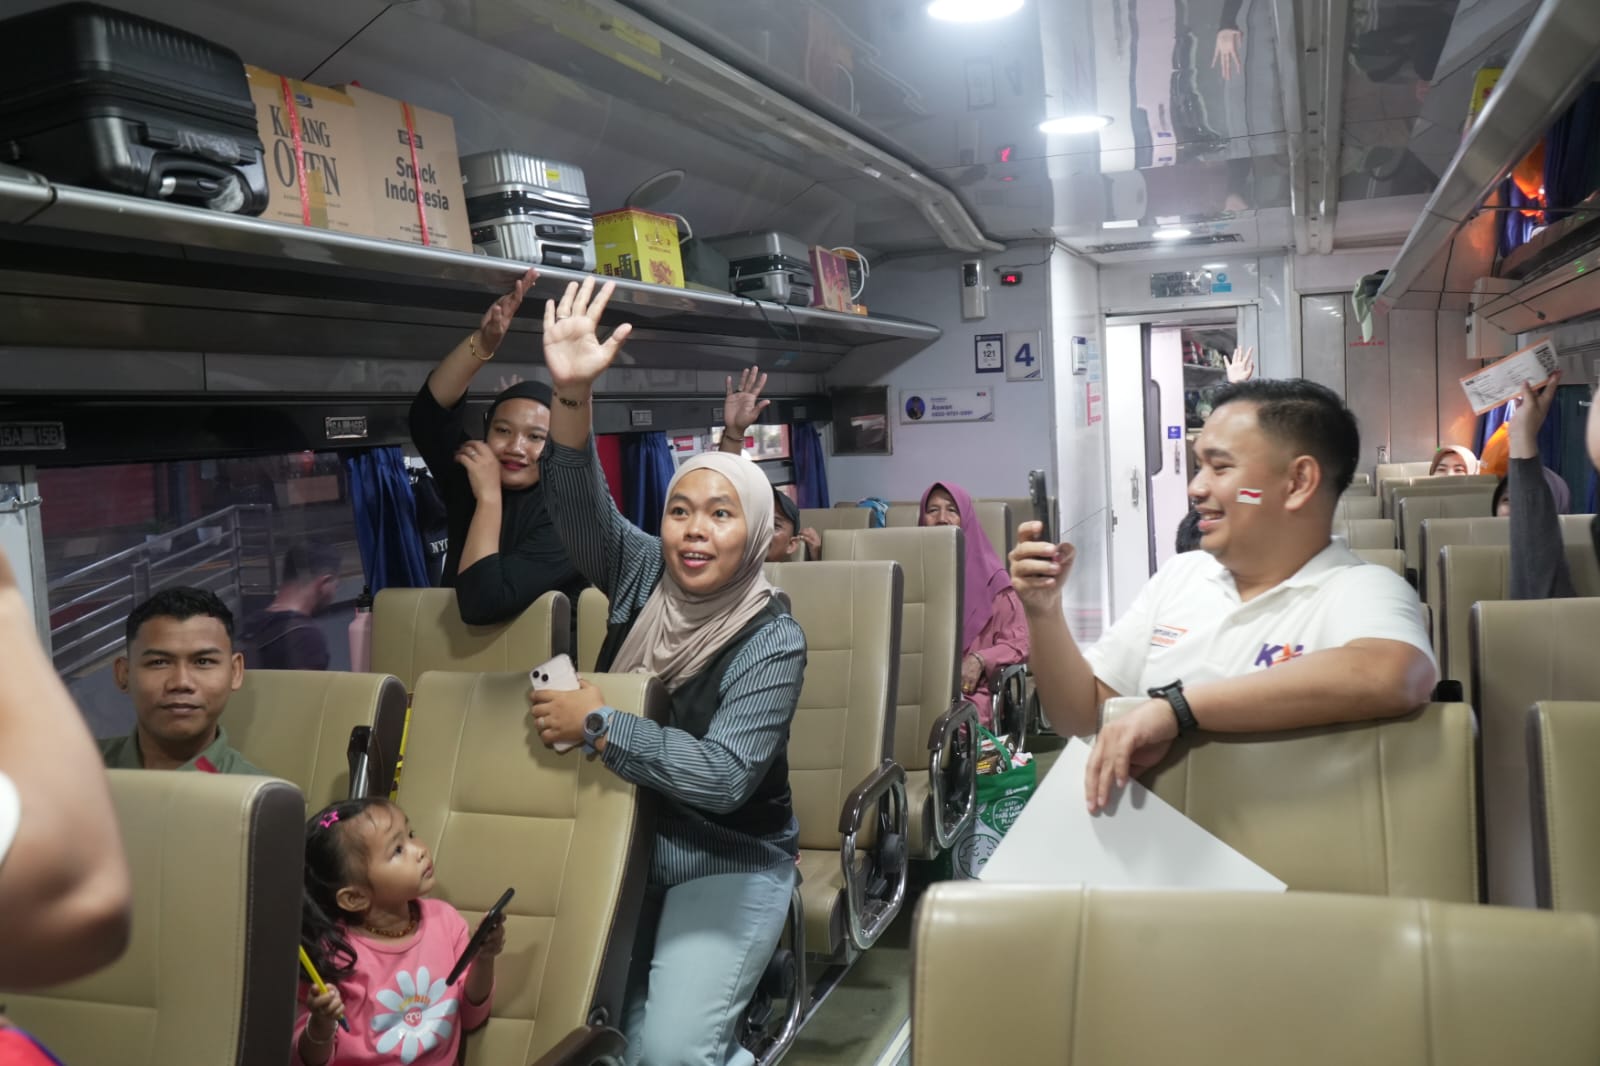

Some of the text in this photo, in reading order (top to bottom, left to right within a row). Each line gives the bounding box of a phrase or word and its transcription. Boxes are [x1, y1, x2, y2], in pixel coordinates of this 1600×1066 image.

[269, 104, 331, 148] KANG
[384, 176, 450, 211] Indoesia
[1014, 343, 1035, 367] 4
